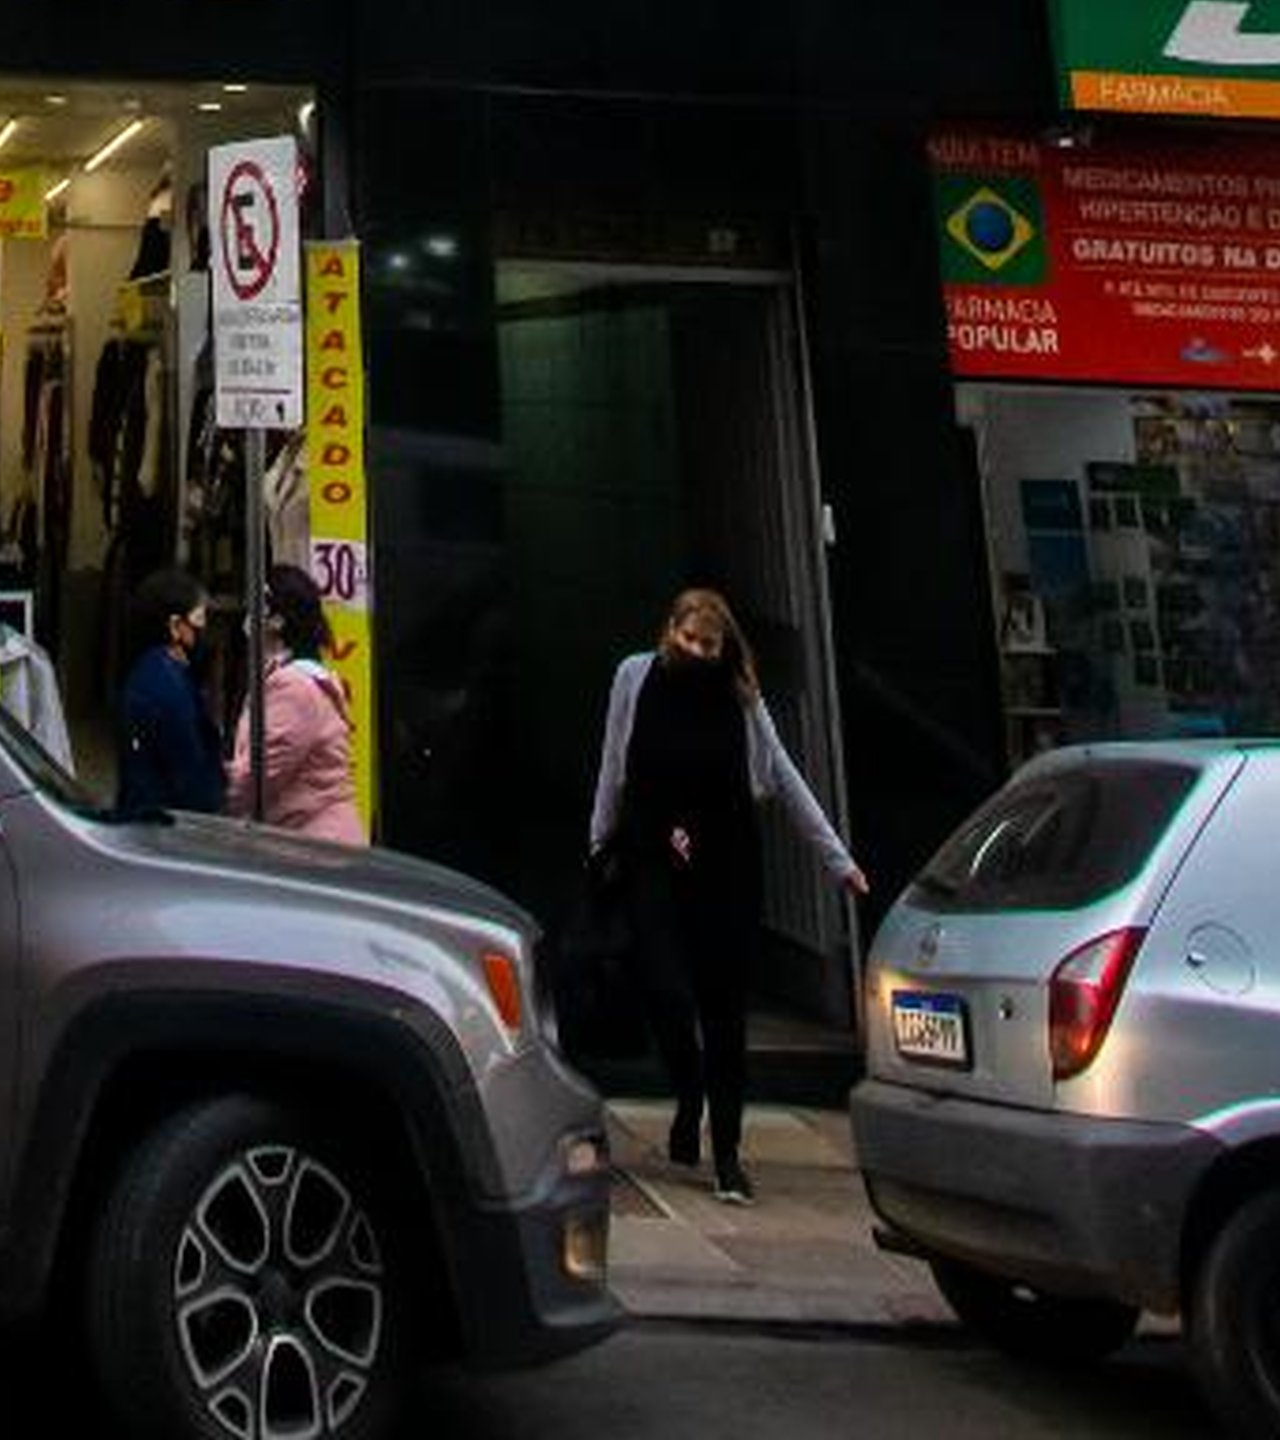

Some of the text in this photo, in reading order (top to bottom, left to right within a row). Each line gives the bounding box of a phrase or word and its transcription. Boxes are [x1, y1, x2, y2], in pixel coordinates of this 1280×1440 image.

[1062, 166, 1249, 197] MEDICAMENTOS
[1072, 237, 1215, 266] GRATUITOS
[1223, 241, 1258, 269] NA
[946, 323, 1060, 357] POPULAR
[320, 250, 352, 505] ATACADO
[315, 543, 357, 600] 30
